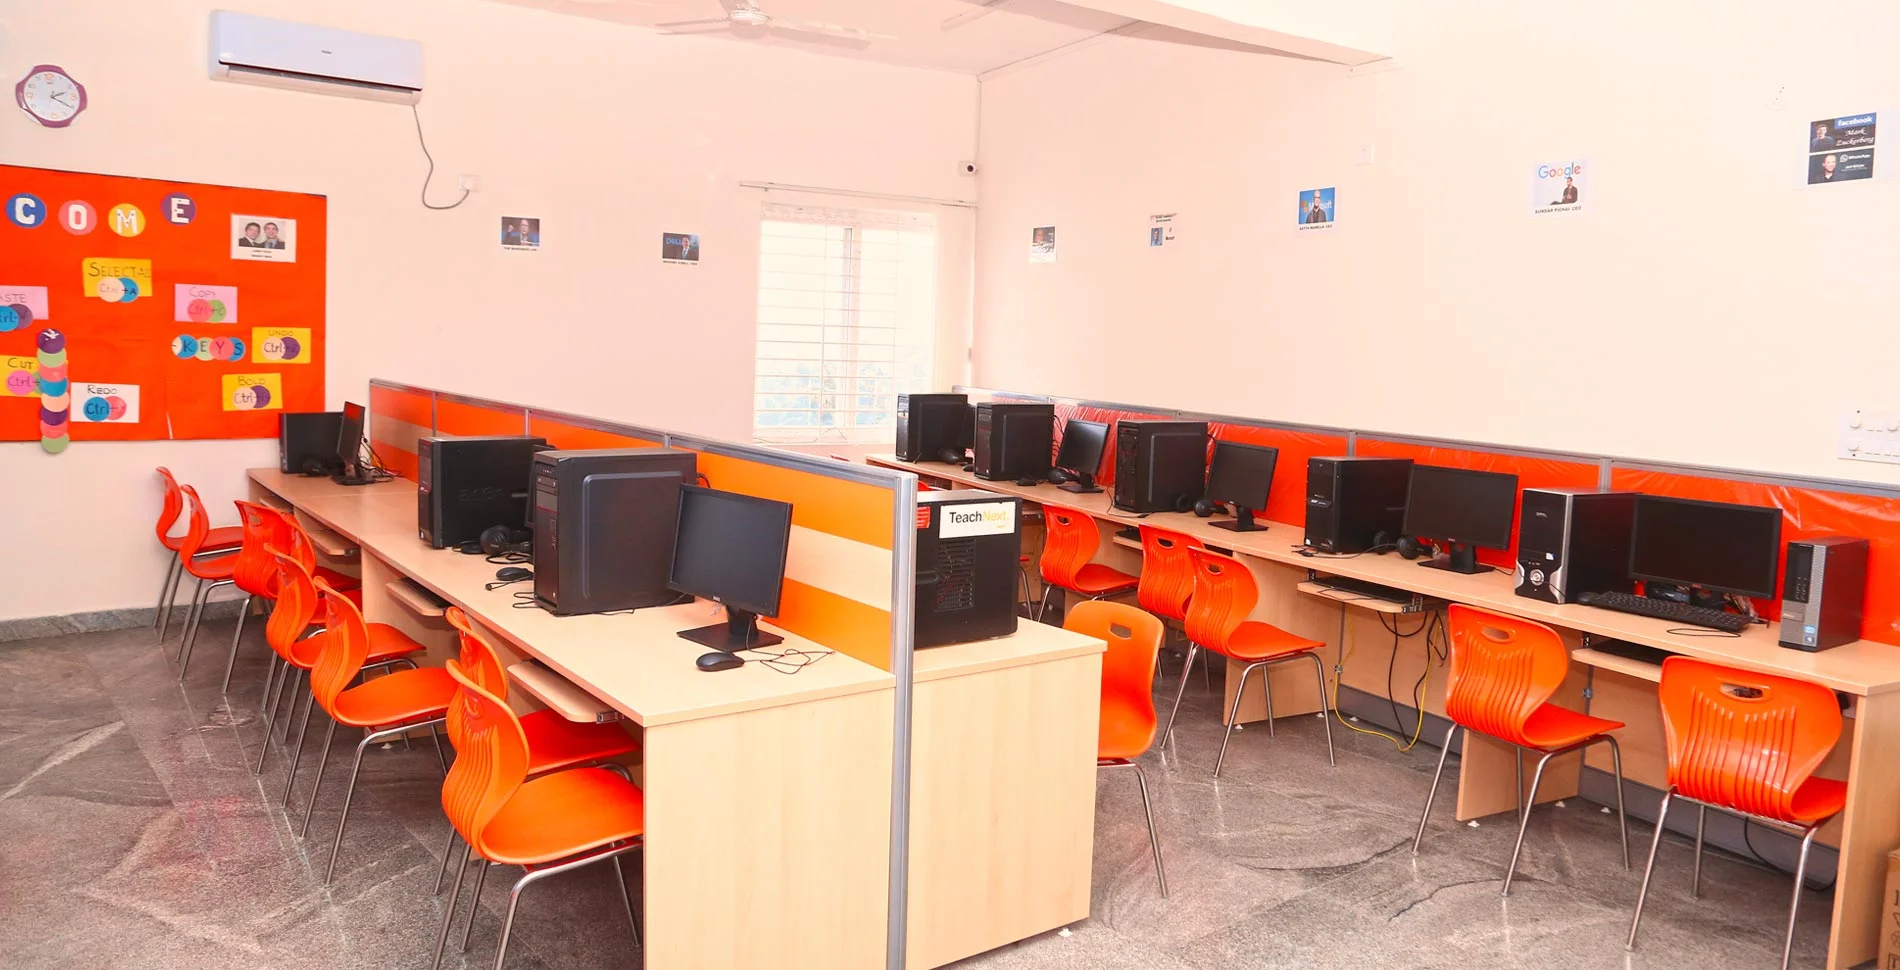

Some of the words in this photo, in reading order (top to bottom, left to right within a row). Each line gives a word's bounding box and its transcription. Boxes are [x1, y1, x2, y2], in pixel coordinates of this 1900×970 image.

[1838, 116, 1873, 127] facebook
[1845, 127, 1867, 137] Mark
[1538, 162, 1581, 180] Google
[88, 261, 137, 278] SELECT
[183, 340, 243, 356] KEYS
[7, 357, 34, 370] CUT
[238, 375, 265, 386] BOLD
[88, 384, 118, 395] REDO
